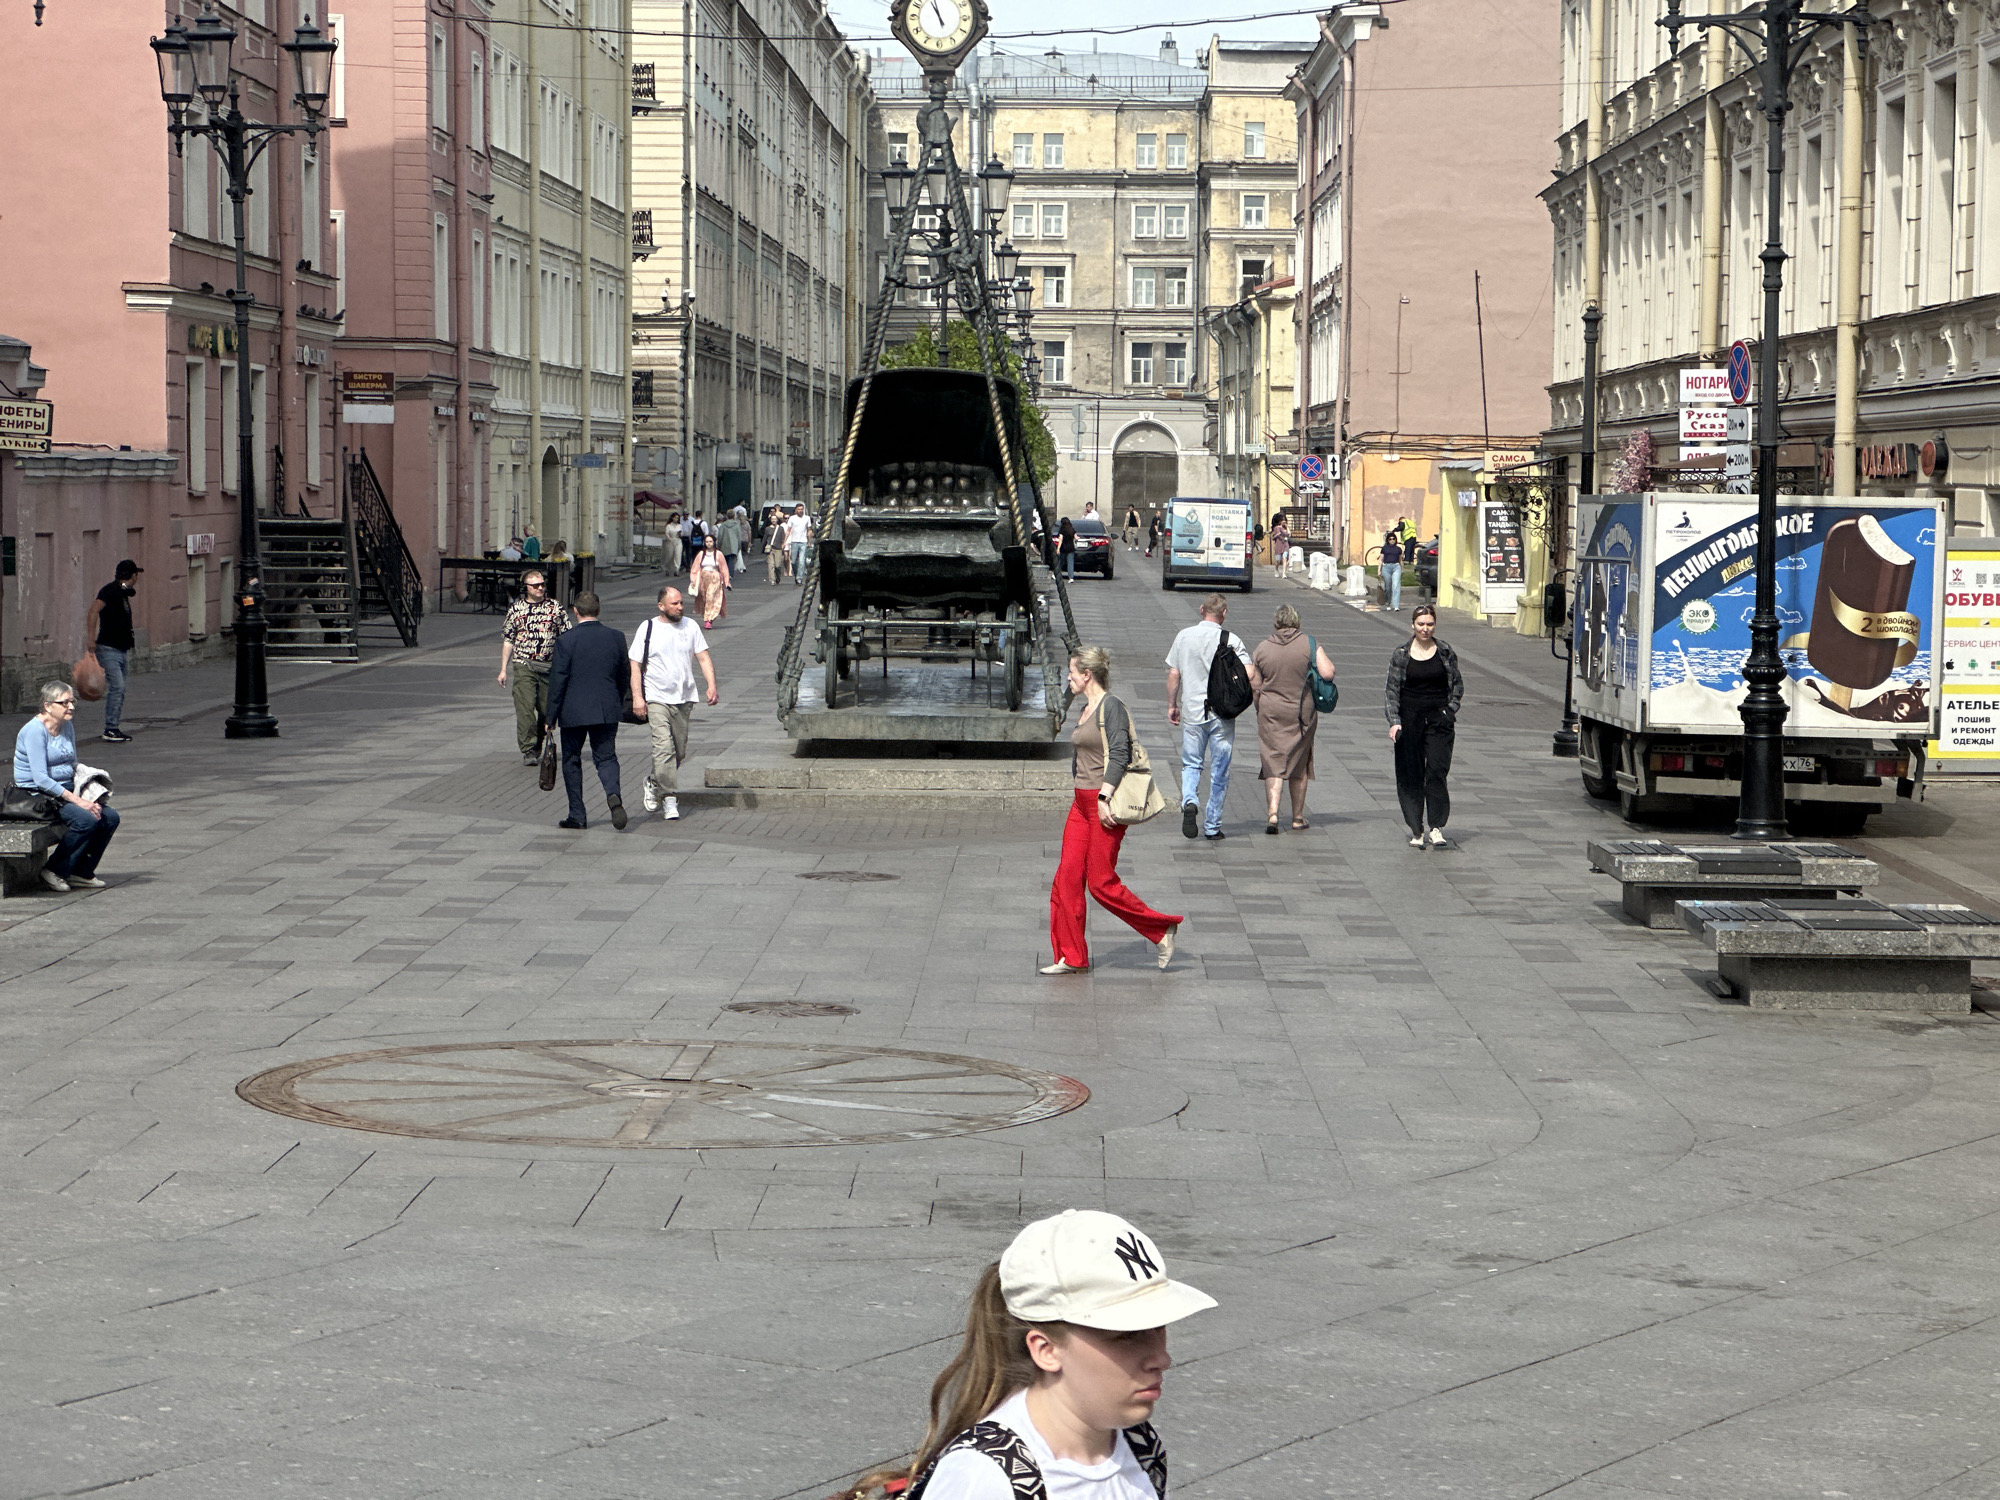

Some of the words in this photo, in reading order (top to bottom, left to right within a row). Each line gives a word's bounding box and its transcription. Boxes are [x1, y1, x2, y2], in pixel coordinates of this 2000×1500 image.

[1686, 376, 1731, 390] НОТАРИ
[1690, 421, 1725, 430] Сказ
[1661, 512, 1814, 598] ЛЕНИНГРАКОЕ
[1883, 616, 1919, 628] двойном
[1877, 626, 1918, 636] шоколаде
[1947, 701, 2000, 710] АТЕЛЬЕ
[1114, 1231, 1160, 1281] NY
